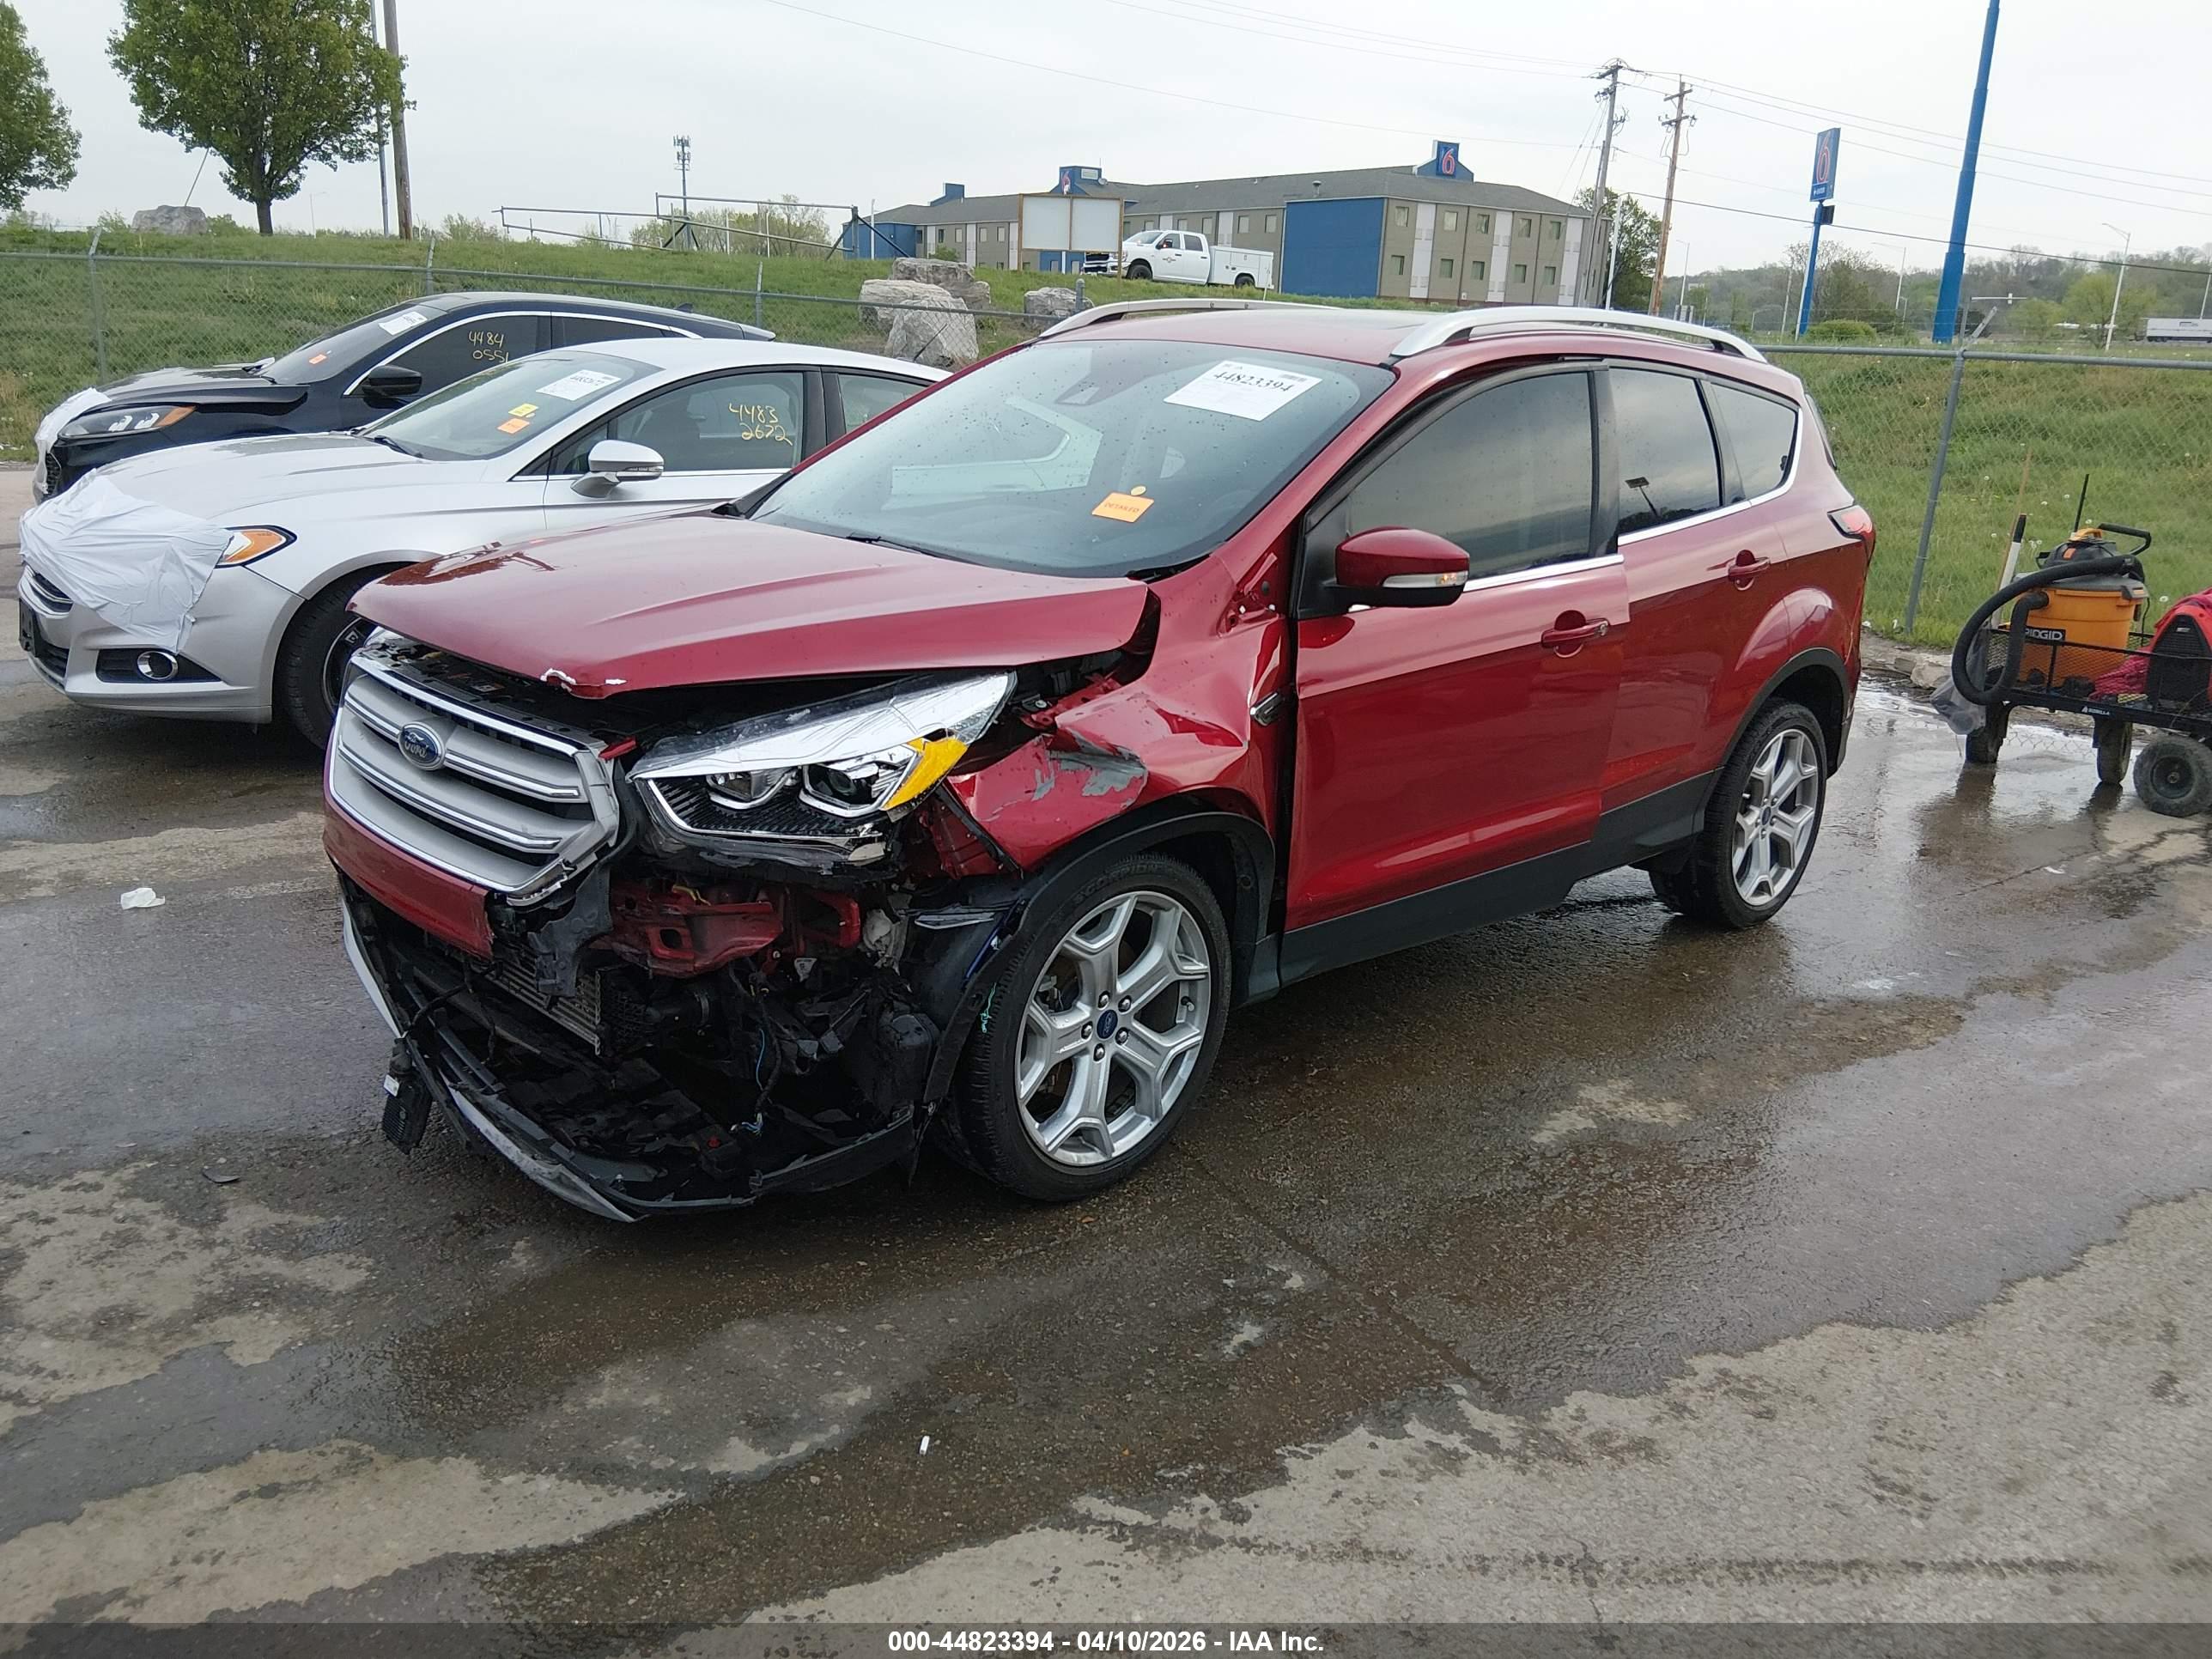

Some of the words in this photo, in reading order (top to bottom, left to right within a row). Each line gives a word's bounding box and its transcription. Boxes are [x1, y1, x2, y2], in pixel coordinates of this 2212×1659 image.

[1443, 148, 1455, 175] 6
[469, 331, 505, 349] 4484
[1213, 371, 1295, 392] 44823394
[729, 403, 779, 423] 4483
[739, 422, 793, 446] 2672
